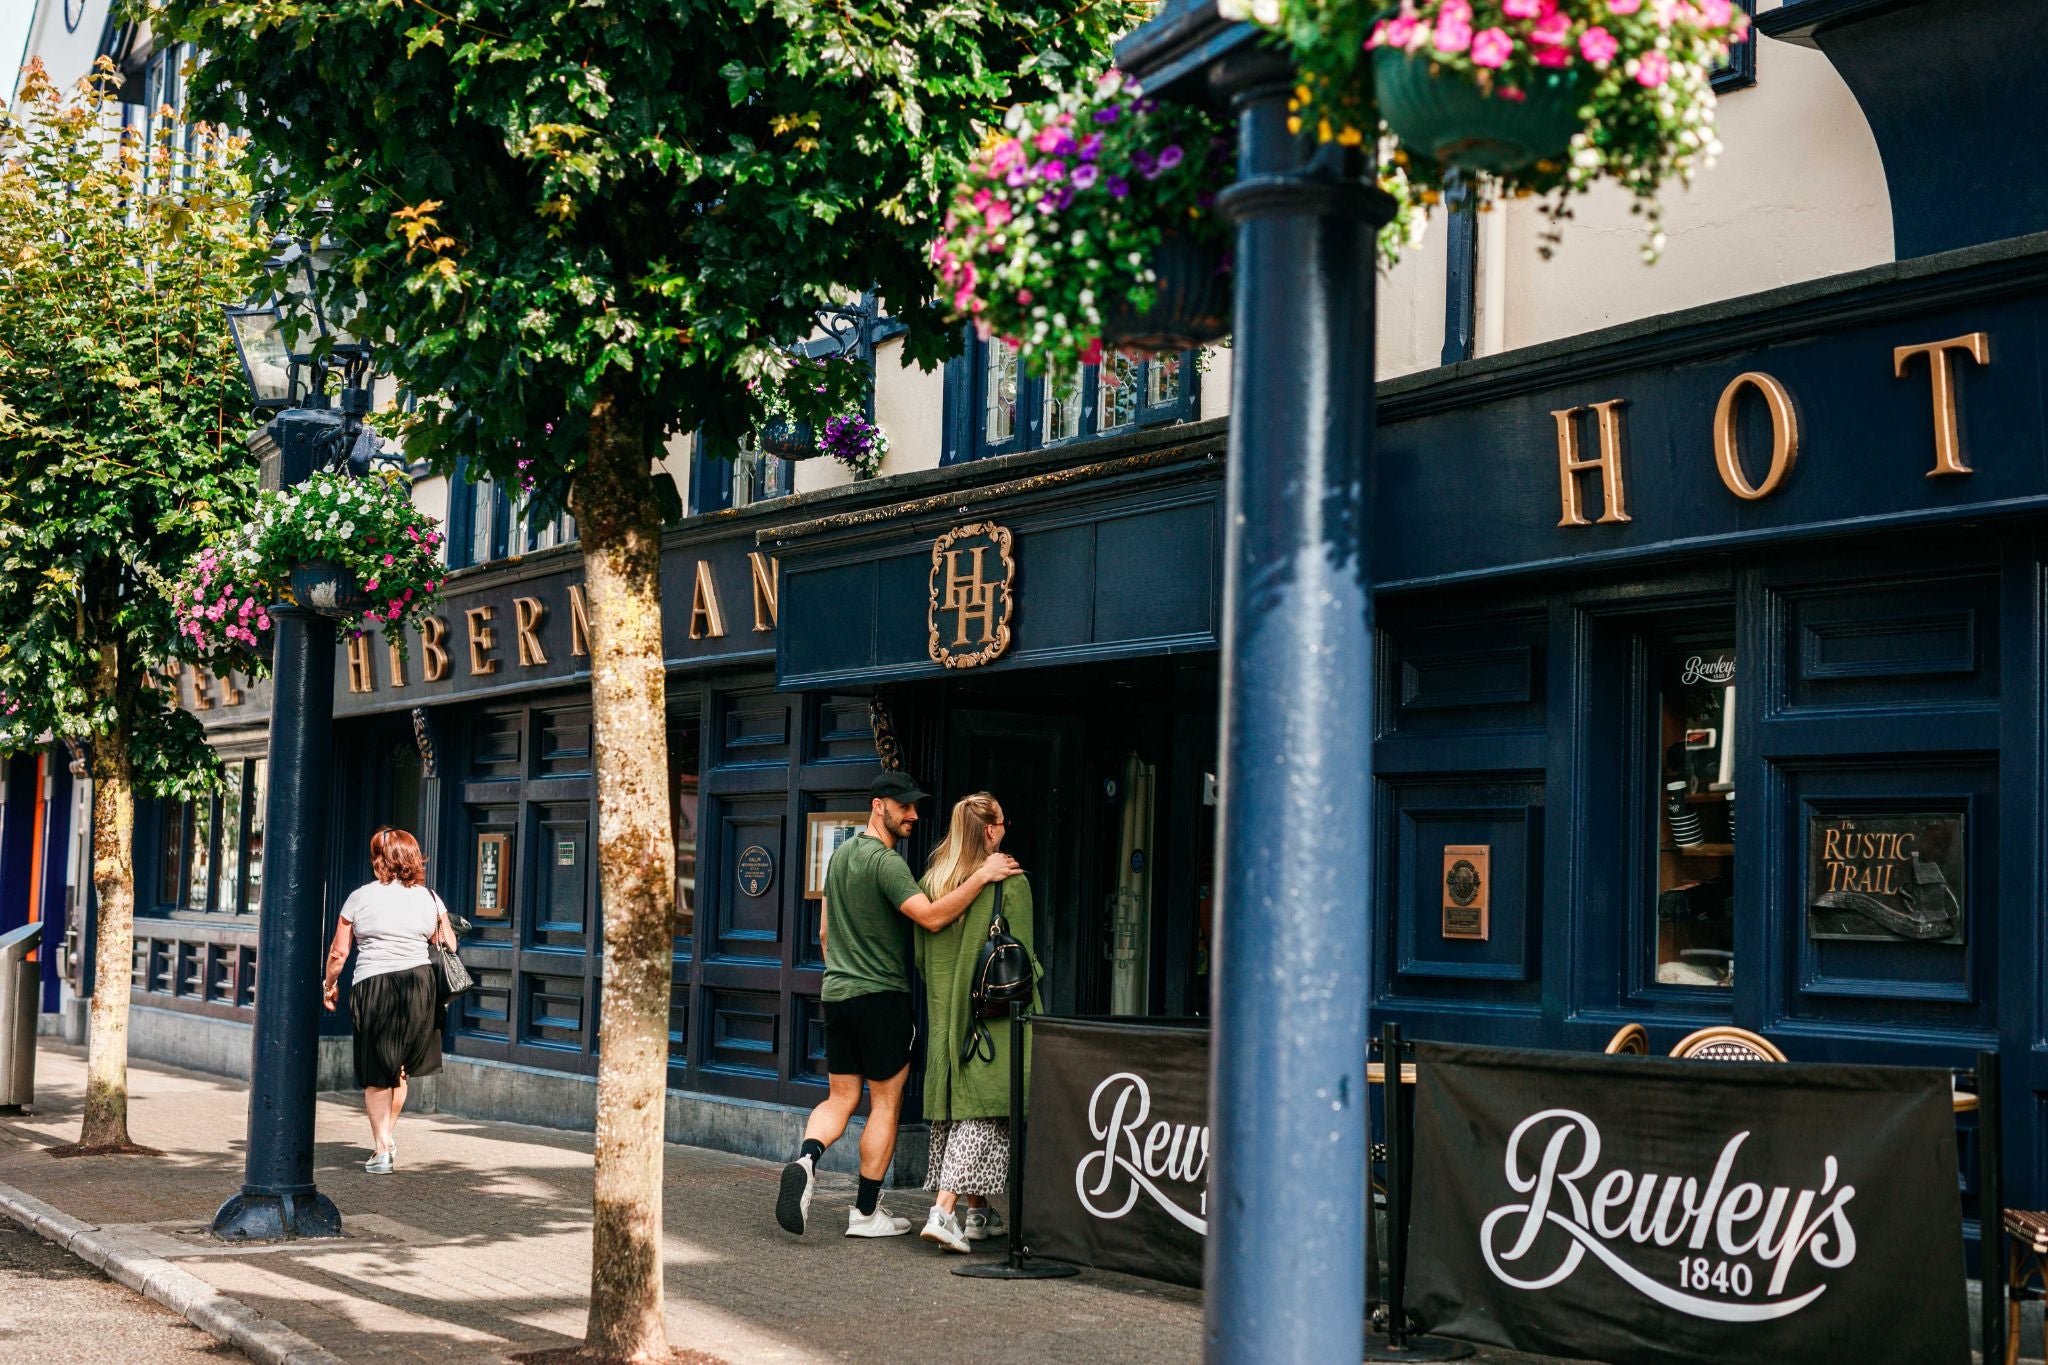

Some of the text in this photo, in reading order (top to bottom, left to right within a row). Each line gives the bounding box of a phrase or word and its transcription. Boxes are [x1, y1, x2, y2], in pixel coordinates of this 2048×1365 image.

[347, 551, 778, 693] HIBERNAN
[1823, 828, 1914, 861] RUSTIC
[1826, 861, 1898, 895] TRAIL
[1480, 1108, 1857, 1321] Bewley's
[1679, 1256, 1753, 1297] 1840
